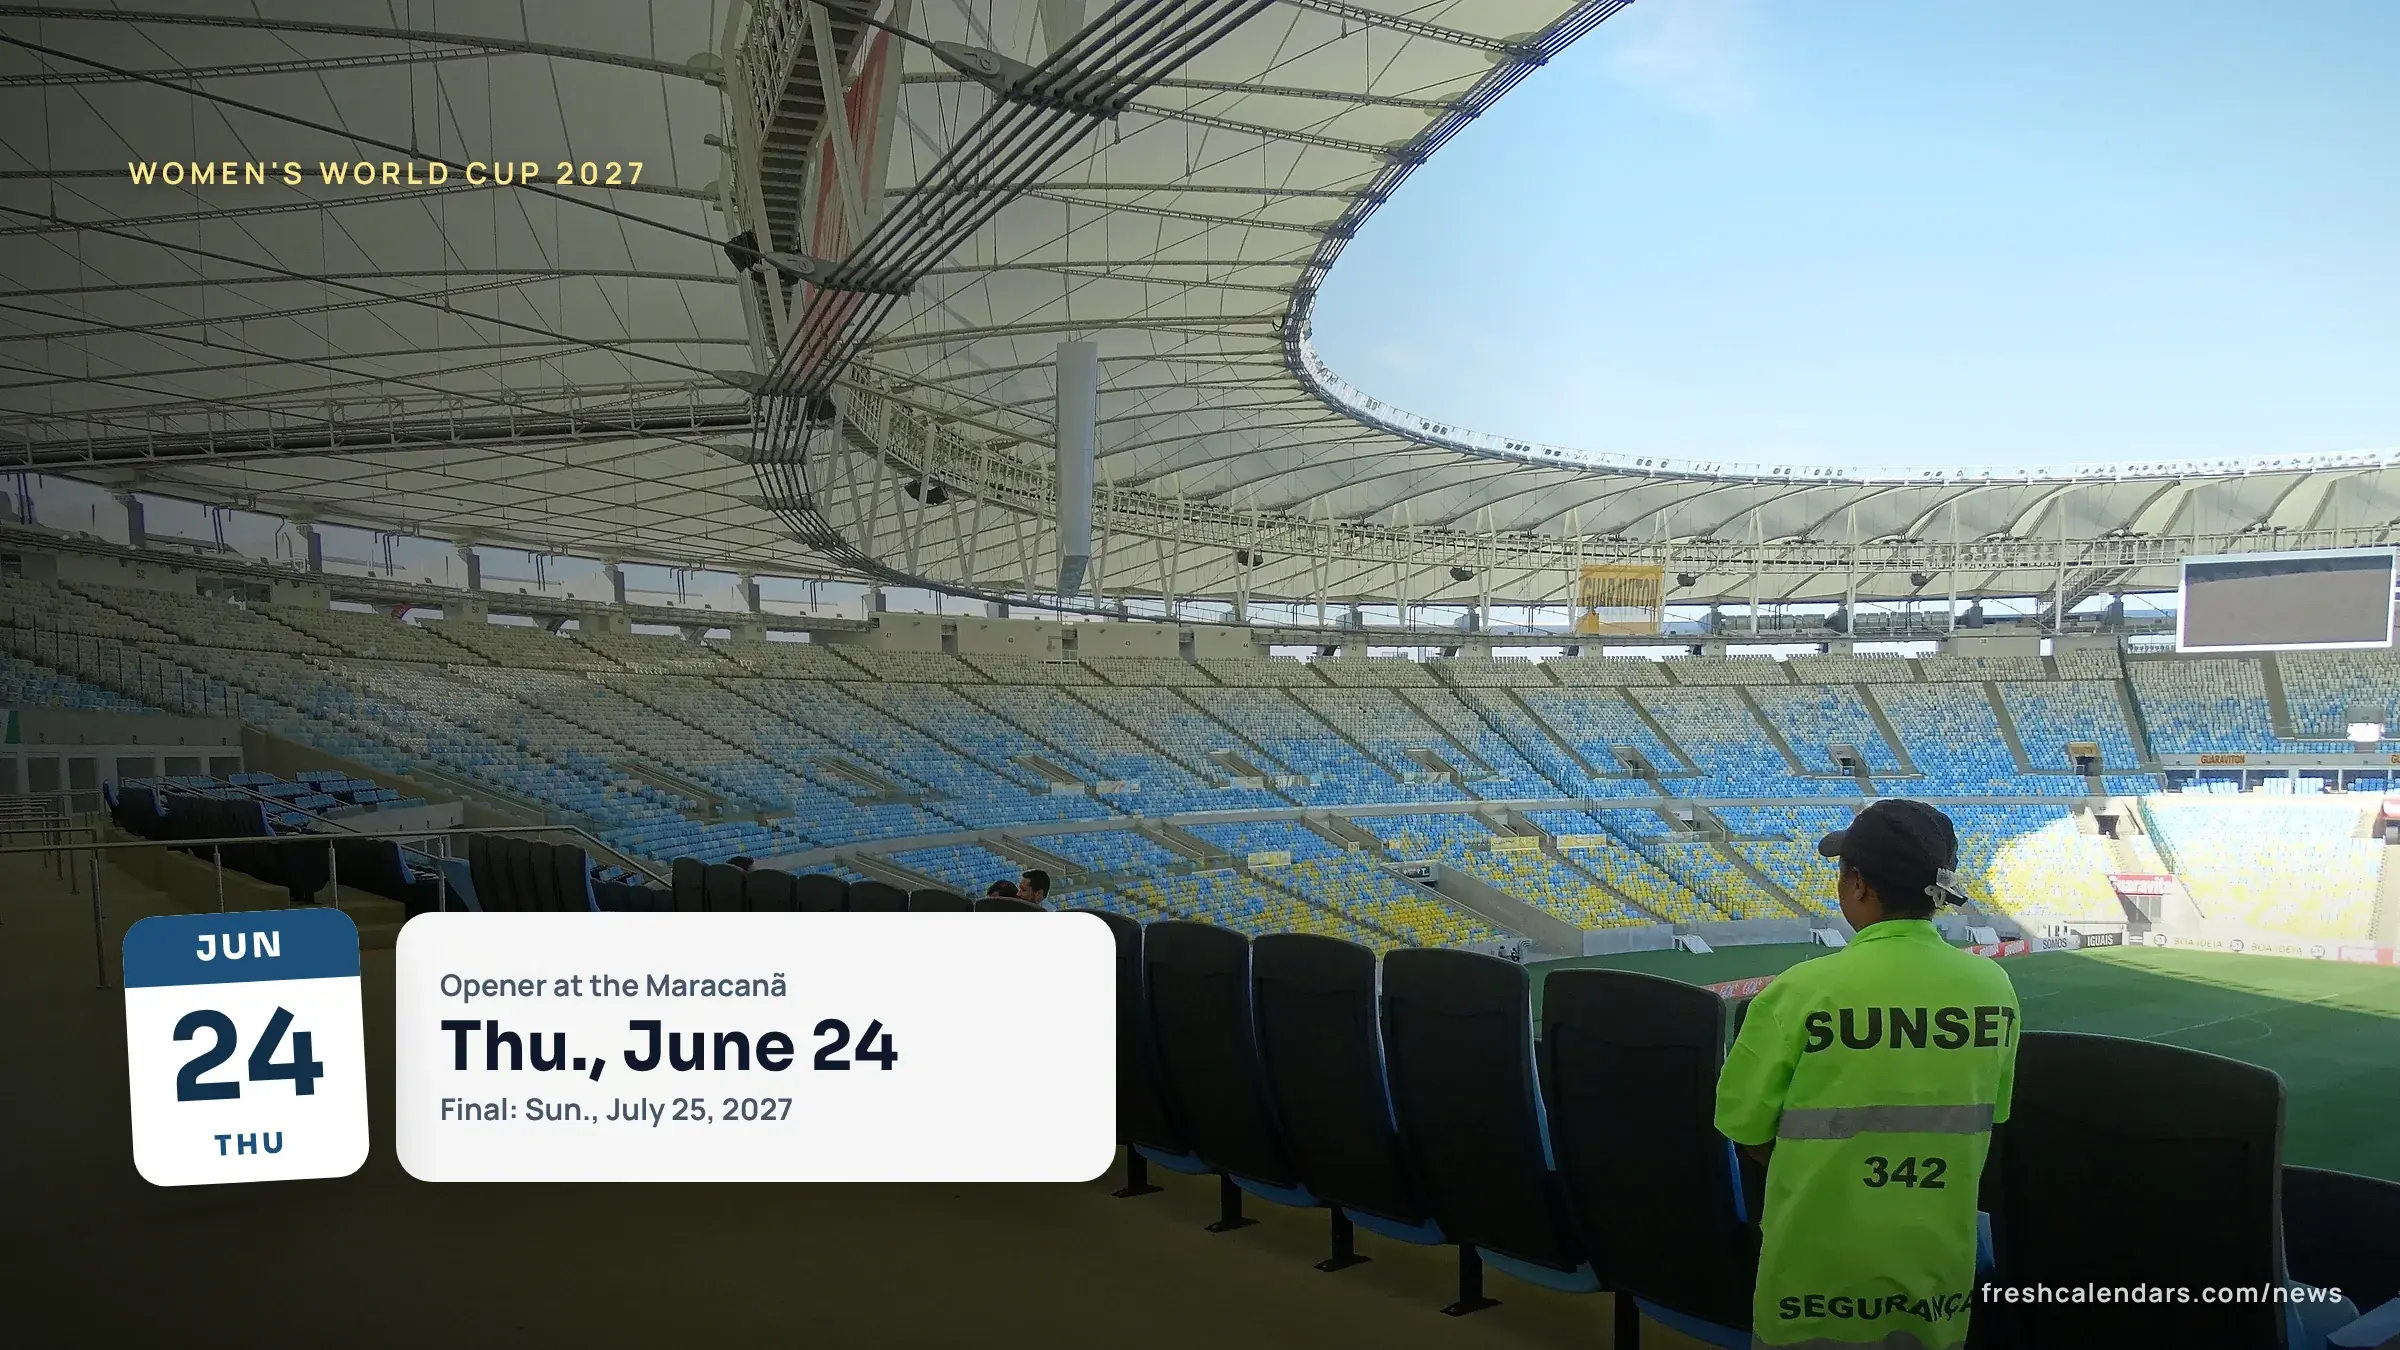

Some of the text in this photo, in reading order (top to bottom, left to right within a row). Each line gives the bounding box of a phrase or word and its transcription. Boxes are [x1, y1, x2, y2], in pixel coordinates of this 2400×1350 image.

[2200, 754, 2246, 765] GUARAVITON
[2042, 938, 2068, 950] SOMOS
[2087, 934, 2114, 947] IGUAIS
[1804, 1006, 2016, 1053] SUNSET
[1863, 1156, 1948, 1189] 342
